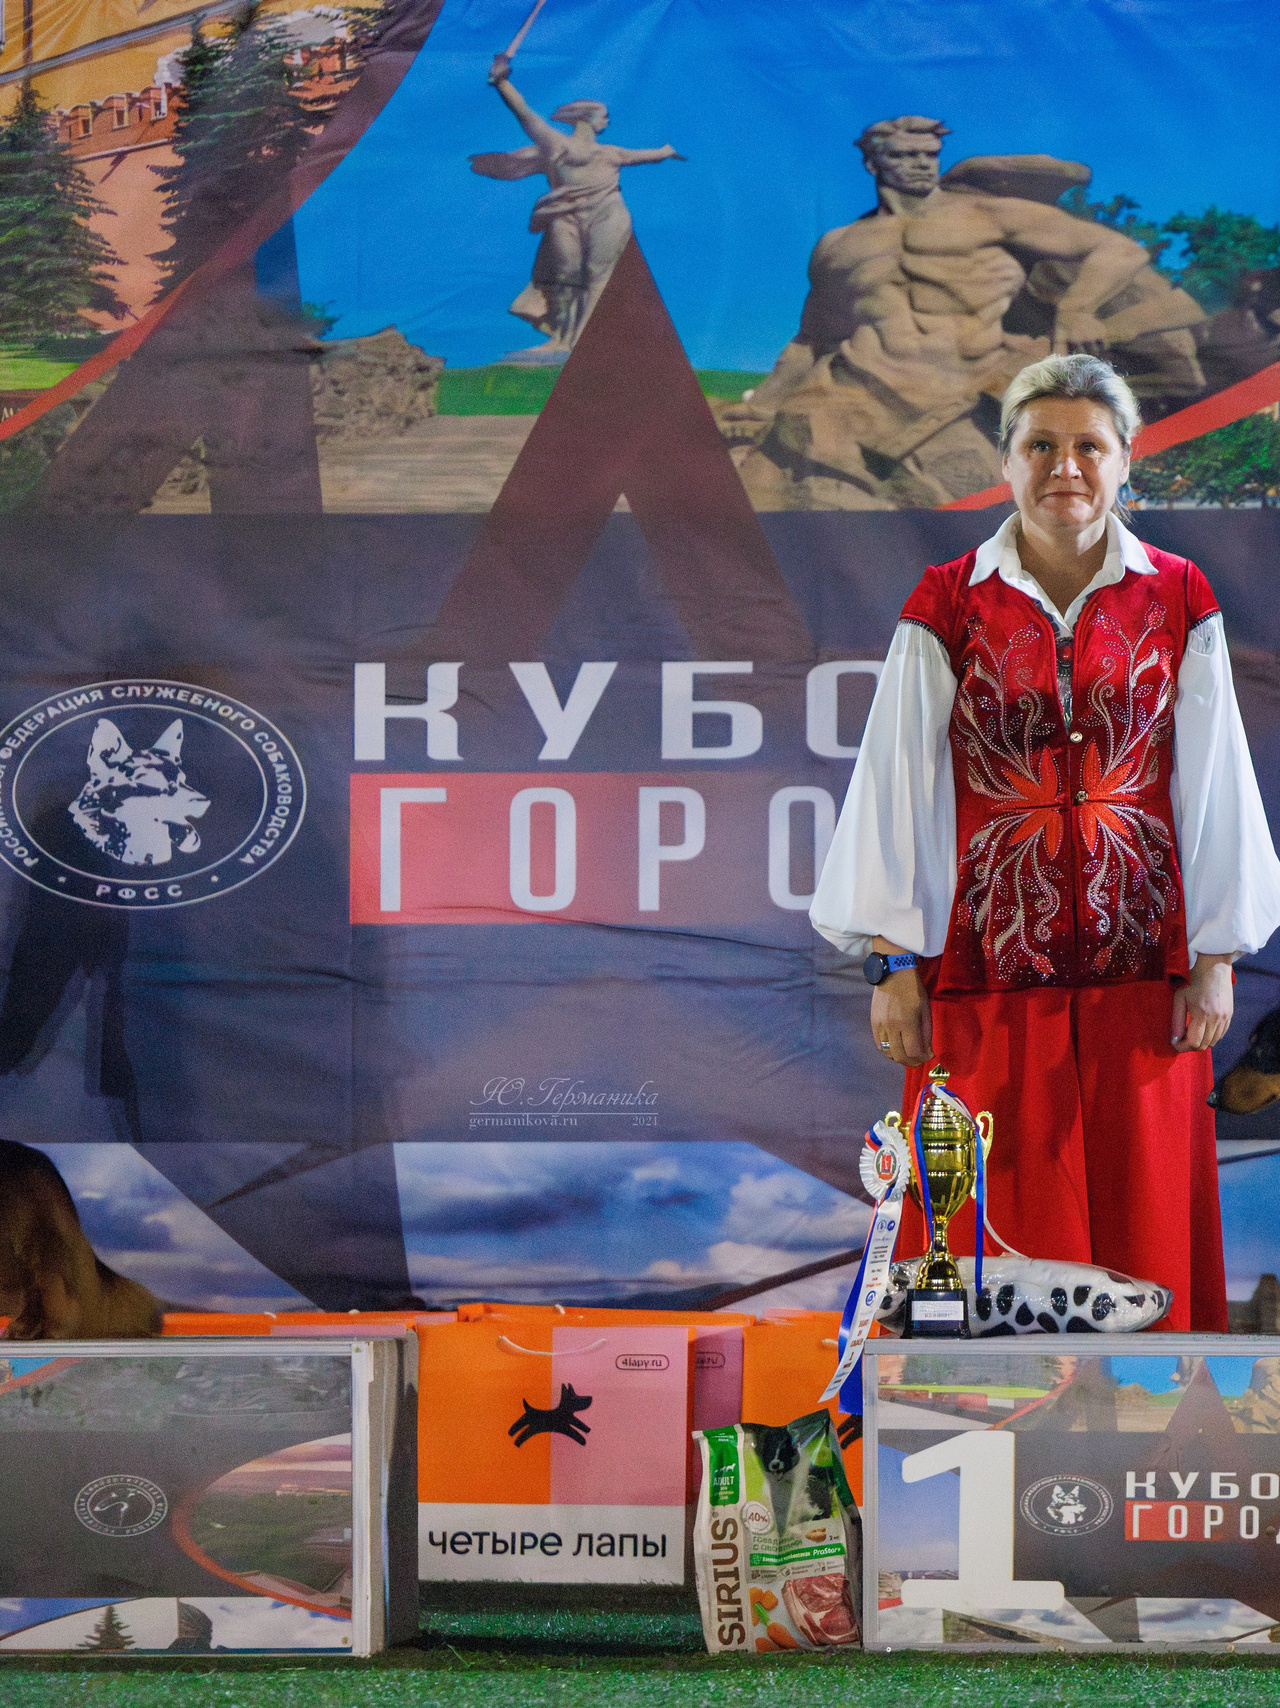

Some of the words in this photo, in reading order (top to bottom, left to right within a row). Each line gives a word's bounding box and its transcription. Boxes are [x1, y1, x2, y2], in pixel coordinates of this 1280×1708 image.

[354, 660, 888, 761] КУБО
[111, 684, 256, 731] СЛУЖЕБНОГО
[239, 732, 293, 865] СОБАКОВОДСТВА
[96, 884, 183, 901] РФСС
[380, 785, 836, 912] ГОРО
[713, 1475, 735, 1487] ADULT
[748, 1511, 769, 1523] 40%
[901, 1429, 1066, 1611] 1
[428, 1530, 563, 1556] четыре
[572, 1532, 667, 1558] лапы
[710, 1517, 746, 1646] SIRIUS
